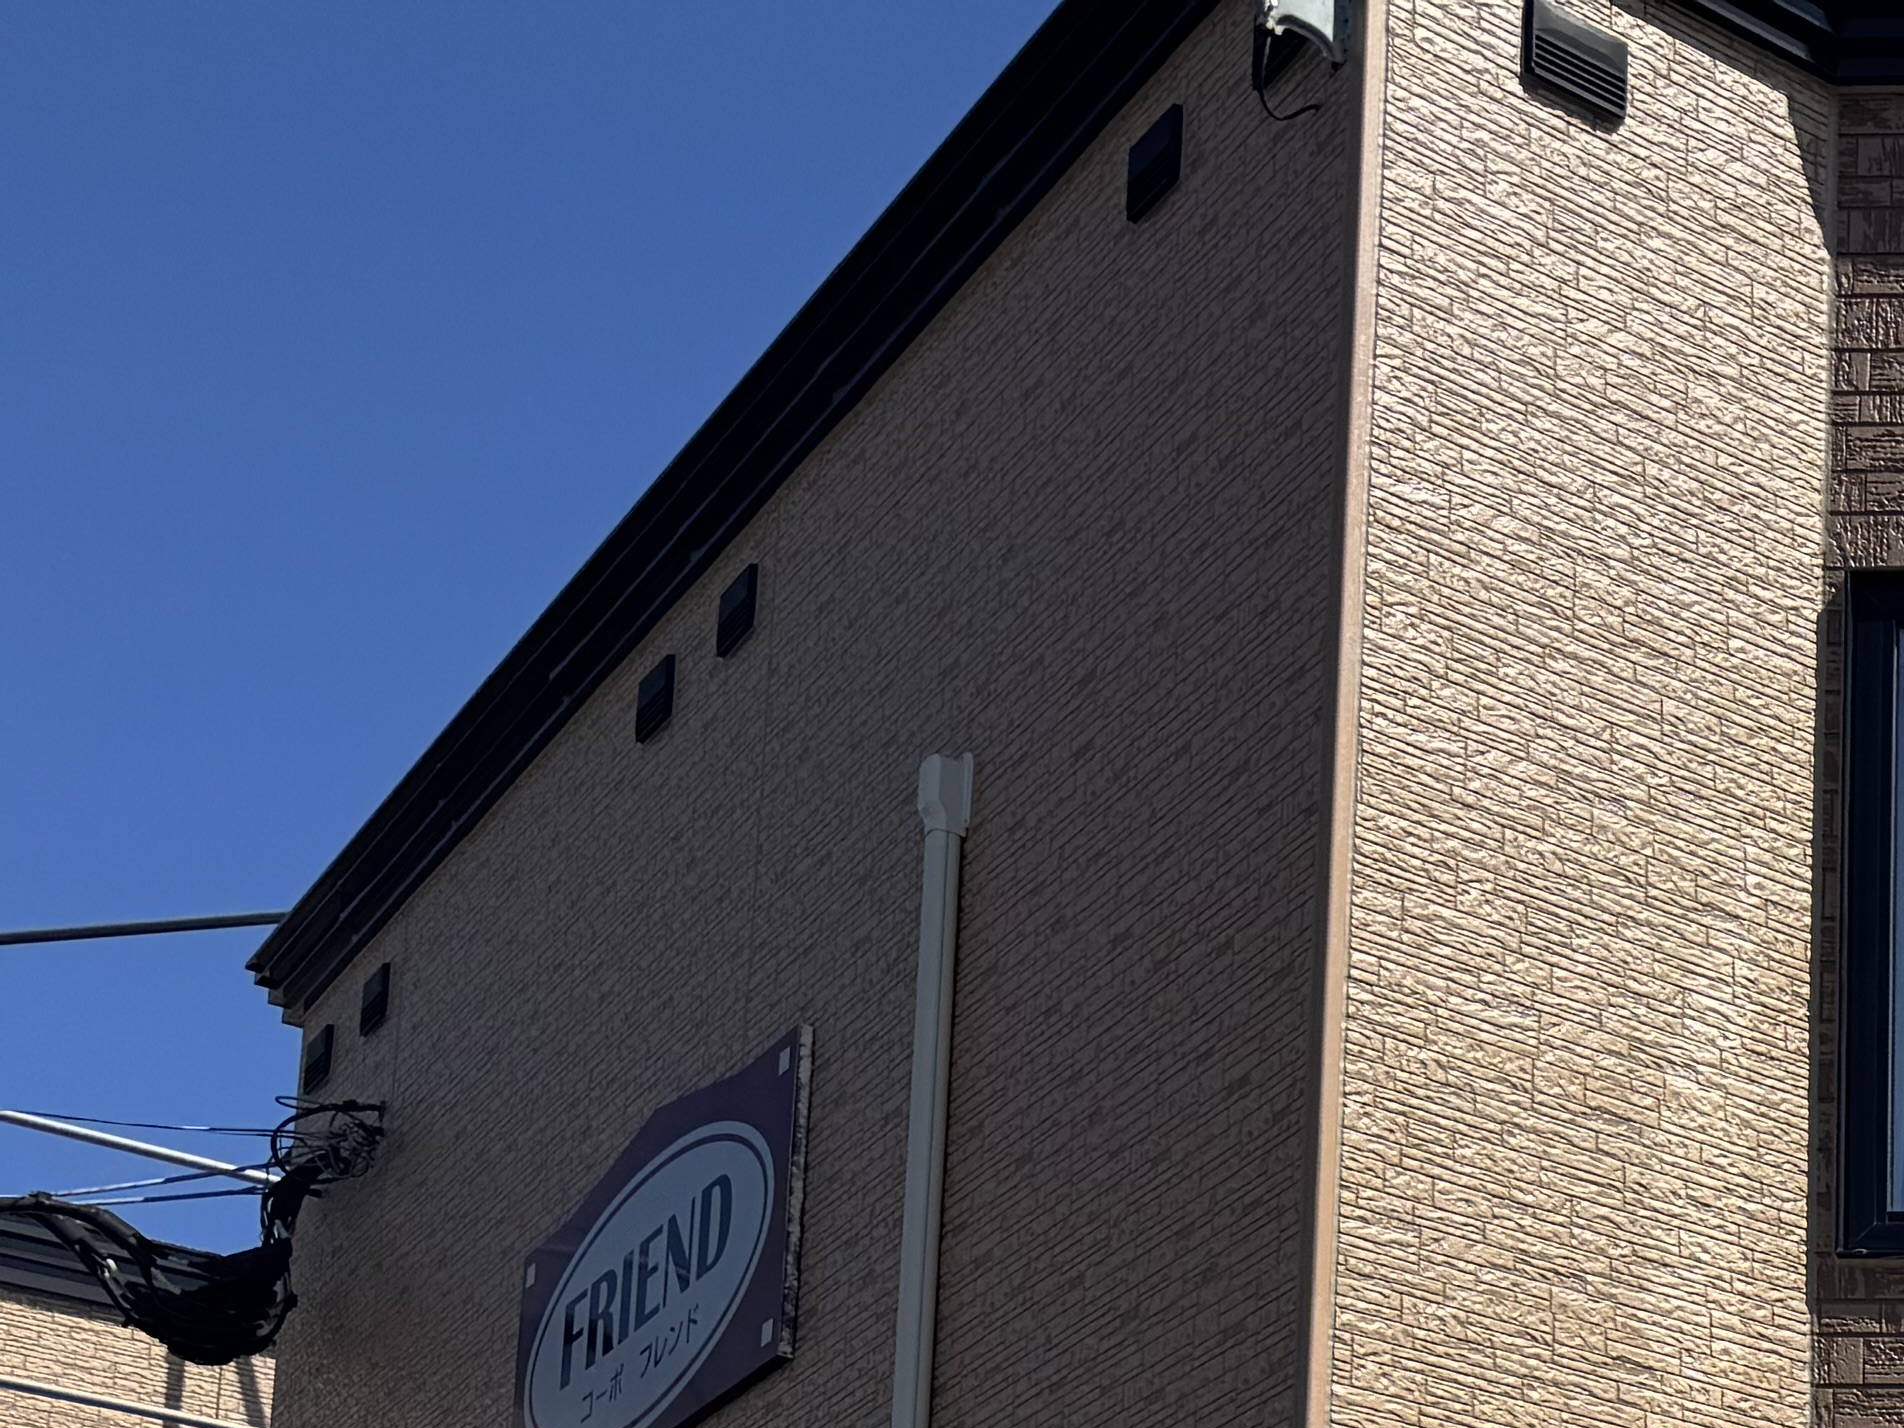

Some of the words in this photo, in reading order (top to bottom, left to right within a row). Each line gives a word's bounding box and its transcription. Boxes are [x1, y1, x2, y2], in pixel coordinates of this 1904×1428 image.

[560, 1173, 733, 1391] FRIEND
[640, 1303, 699, 1379] フレンド
